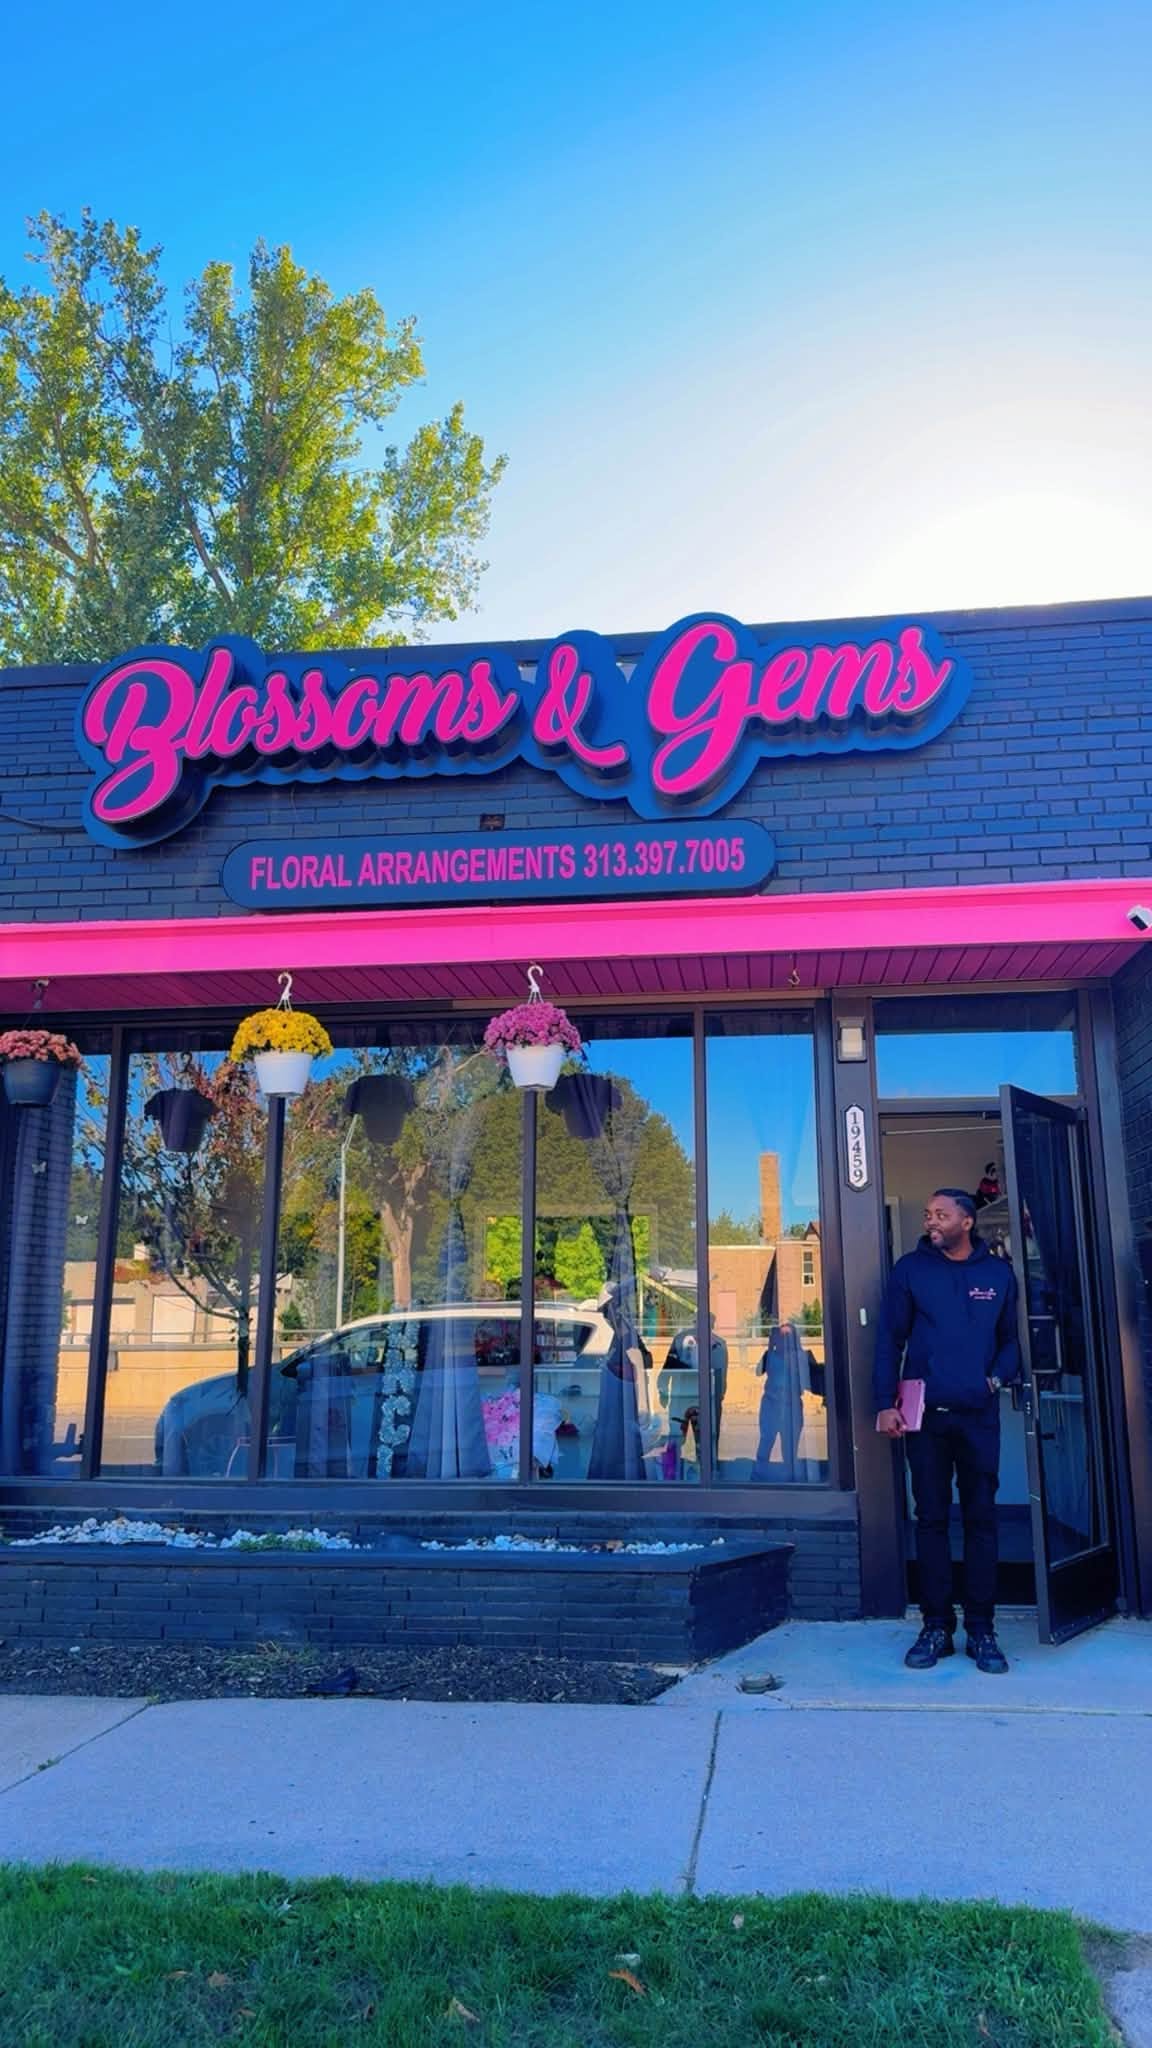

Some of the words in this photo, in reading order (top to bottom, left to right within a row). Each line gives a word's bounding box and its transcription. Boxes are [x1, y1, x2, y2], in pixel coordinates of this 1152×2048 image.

[83, 648, 517, 823] Blossoms
[533, 645, 627, 767] &
[648, 622, 953, 795] Gems
[250, 854, 352, 890] FLORAL
[358, 844, 576, 886] ARRANGEMENTS
[583, 838, 745, 878] 313.397.7005
[850, 1111, 864, 1183] 19459
